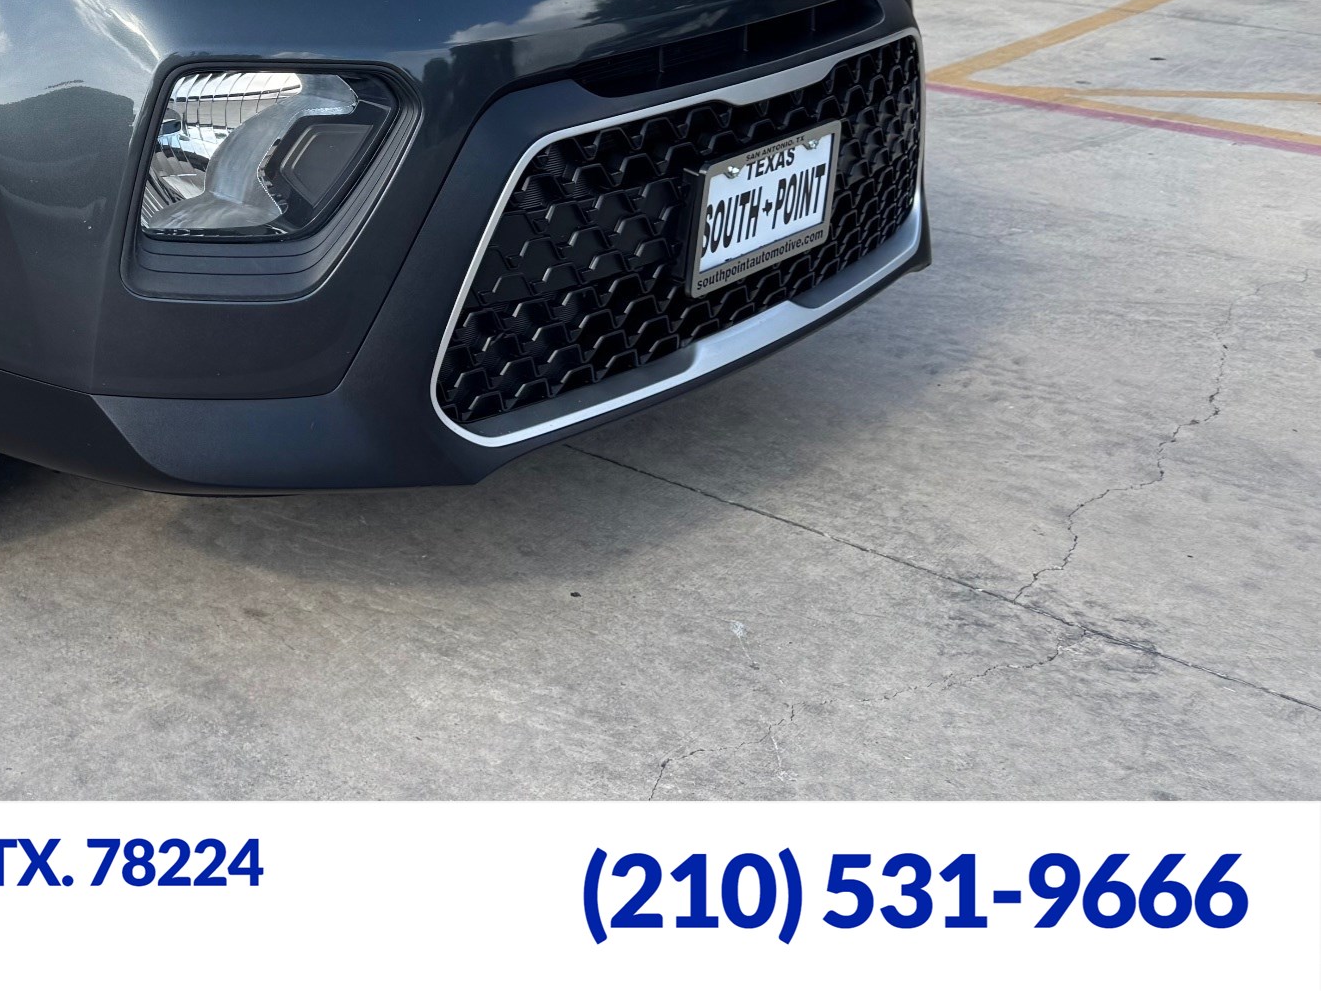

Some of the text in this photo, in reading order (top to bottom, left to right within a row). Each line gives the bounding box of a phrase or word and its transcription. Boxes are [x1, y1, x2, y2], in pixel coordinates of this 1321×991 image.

[745, 150, 761, 162] SAN
[746, 147, 796, 181] TEXAS
[701, 163, 827, 258] SOUTH POINT
[696, 228, 824, 291] southpointautomotive.com
